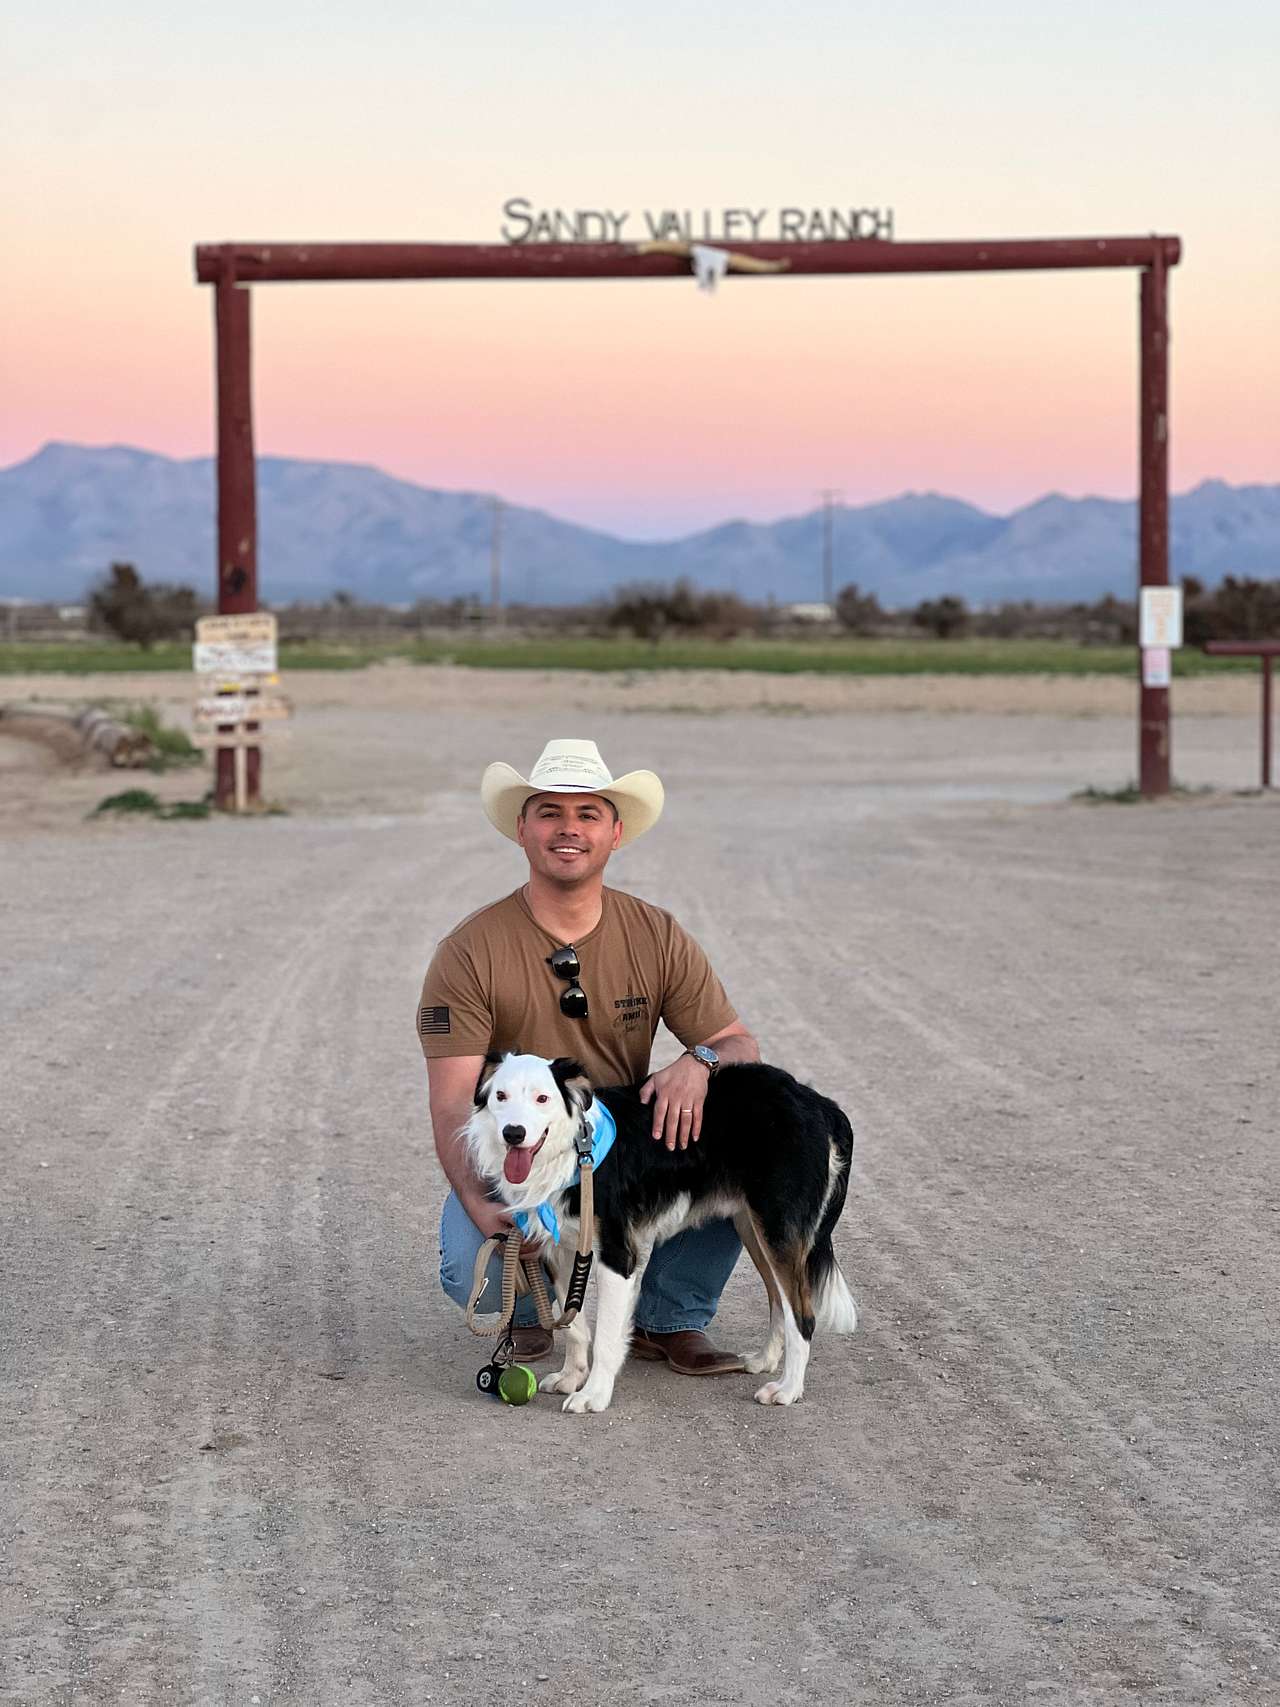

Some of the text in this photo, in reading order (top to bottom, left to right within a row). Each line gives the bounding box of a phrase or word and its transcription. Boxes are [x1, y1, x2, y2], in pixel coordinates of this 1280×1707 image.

[500, 197, 895, 243] SANDY VALLEY RANCH
